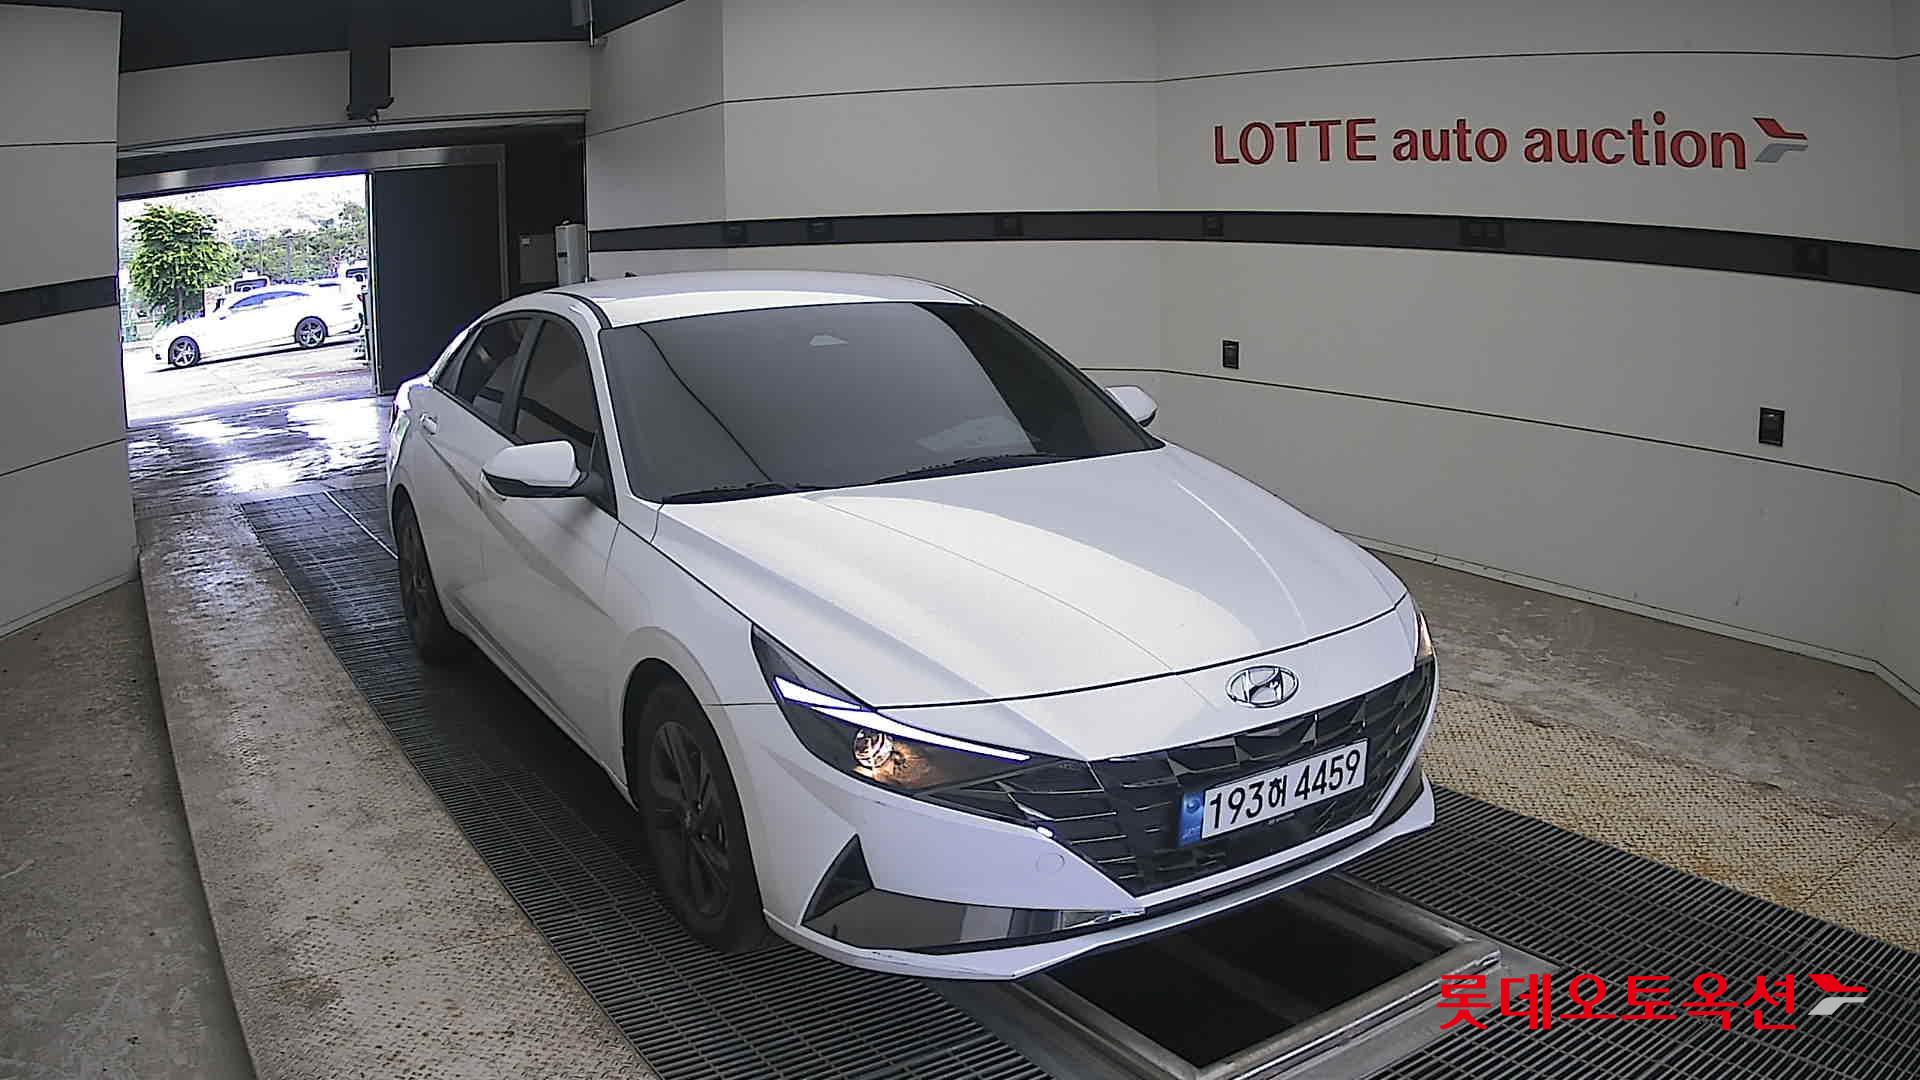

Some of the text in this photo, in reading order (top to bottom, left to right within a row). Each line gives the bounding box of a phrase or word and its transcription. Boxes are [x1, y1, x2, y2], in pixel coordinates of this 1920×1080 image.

[1214, 111, 1747, 170] LOTTE auto auction
[1209, 749, 1361, 829] 193허 4459
